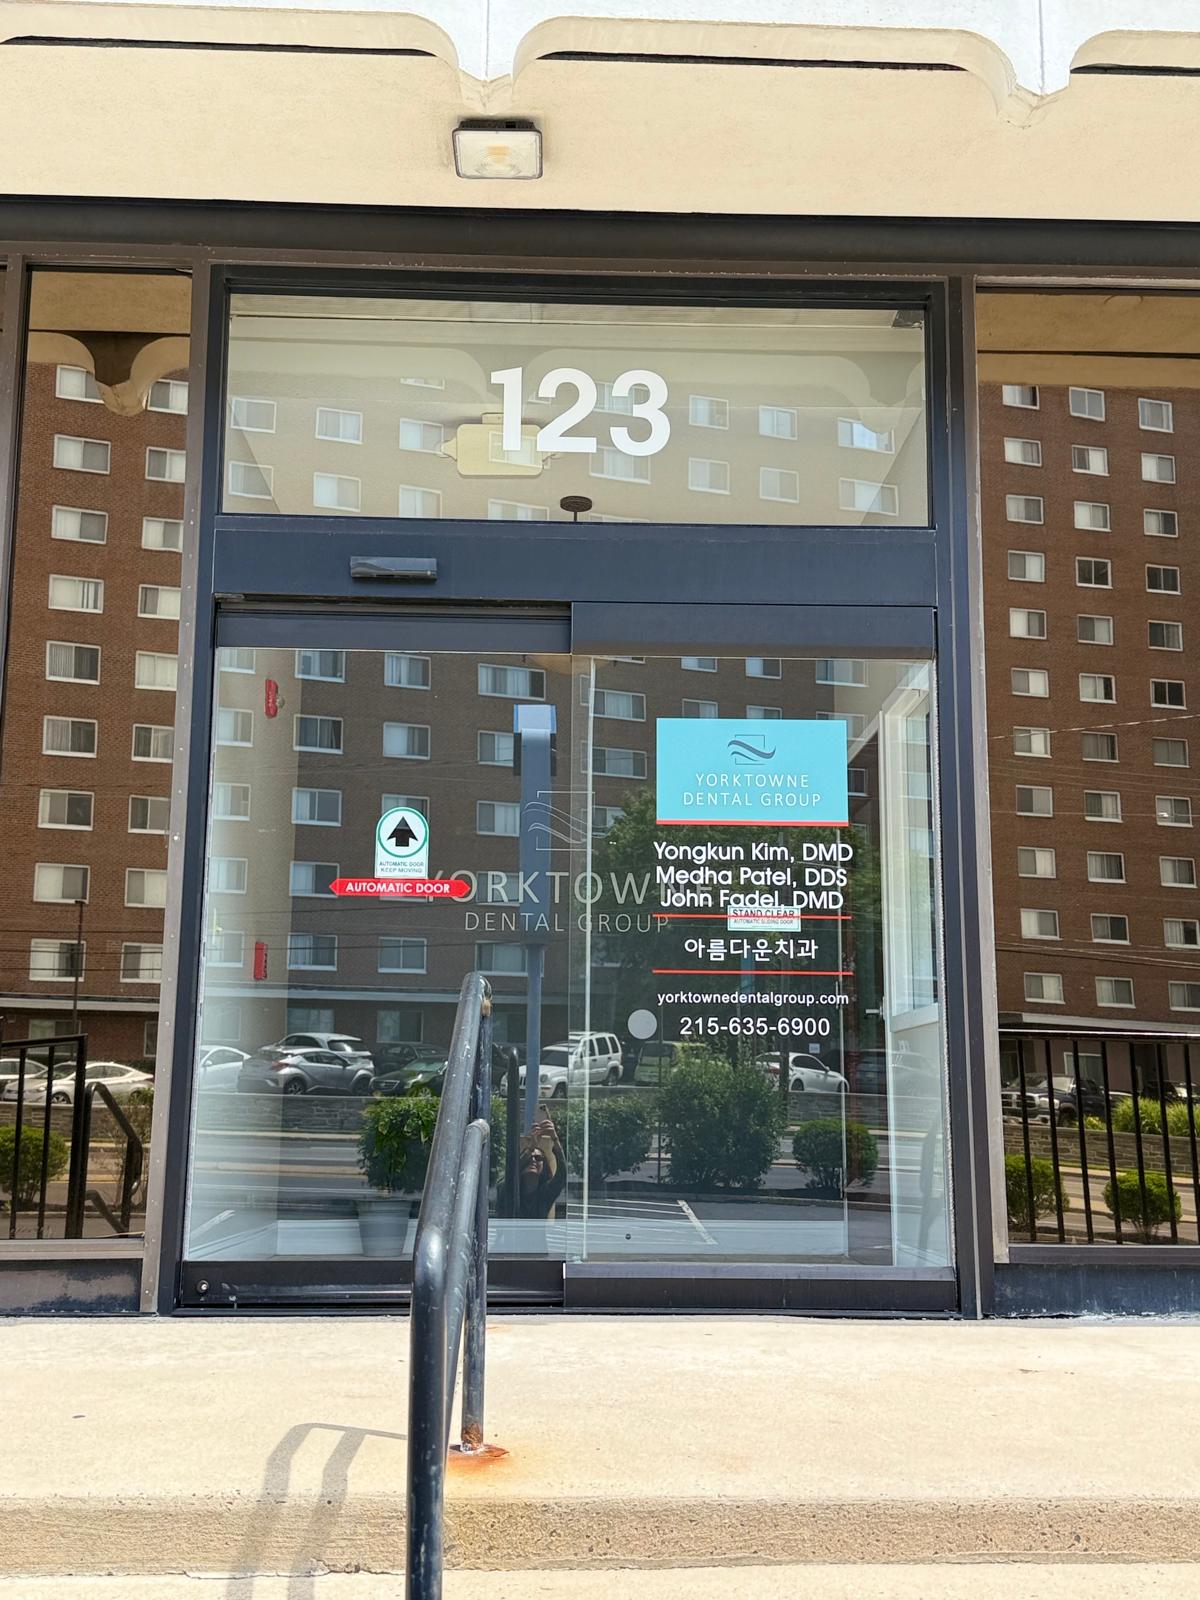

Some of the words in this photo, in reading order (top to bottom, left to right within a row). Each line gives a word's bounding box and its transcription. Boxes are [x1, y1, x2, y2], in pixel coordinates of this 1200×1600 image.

[490, 366, 671, 457] 123
[695, 773, 809, 788] YORKTOWNE
[683, 792, 752, 806] DENTAL
[760, 793, 821, 807] GROUP
[653, 841, 744, 864] Yongkun
[751, 843, 795, 863] Kim,
[802, 843, 853, 862] DMD
[656, 865, 733, 885] Medha
[739, 866, 797, 888] Patel,
[804, 868, 848, 887] DDS
[345, 882, 414, 893] AUTOMATIC
[415, 883, 450, 893] DOOR
[660, 888, 712, 907] John
[719, 889, 785, 912] Fadel,
[793, 891, 844, 909] DMD
[464, 911, 565, 931] DENTAL
[577, 913, 669, 933] GROUP
[732, 908, 763, 918] STAND
[764, 909, 795, 919] CLEAR
[684, 938, 818, 961] 아름다운치과
[657, 991, 849, 1007] yorktownedentalgroup.com
[680, 1016, 830, 1036] 215-635-6900
